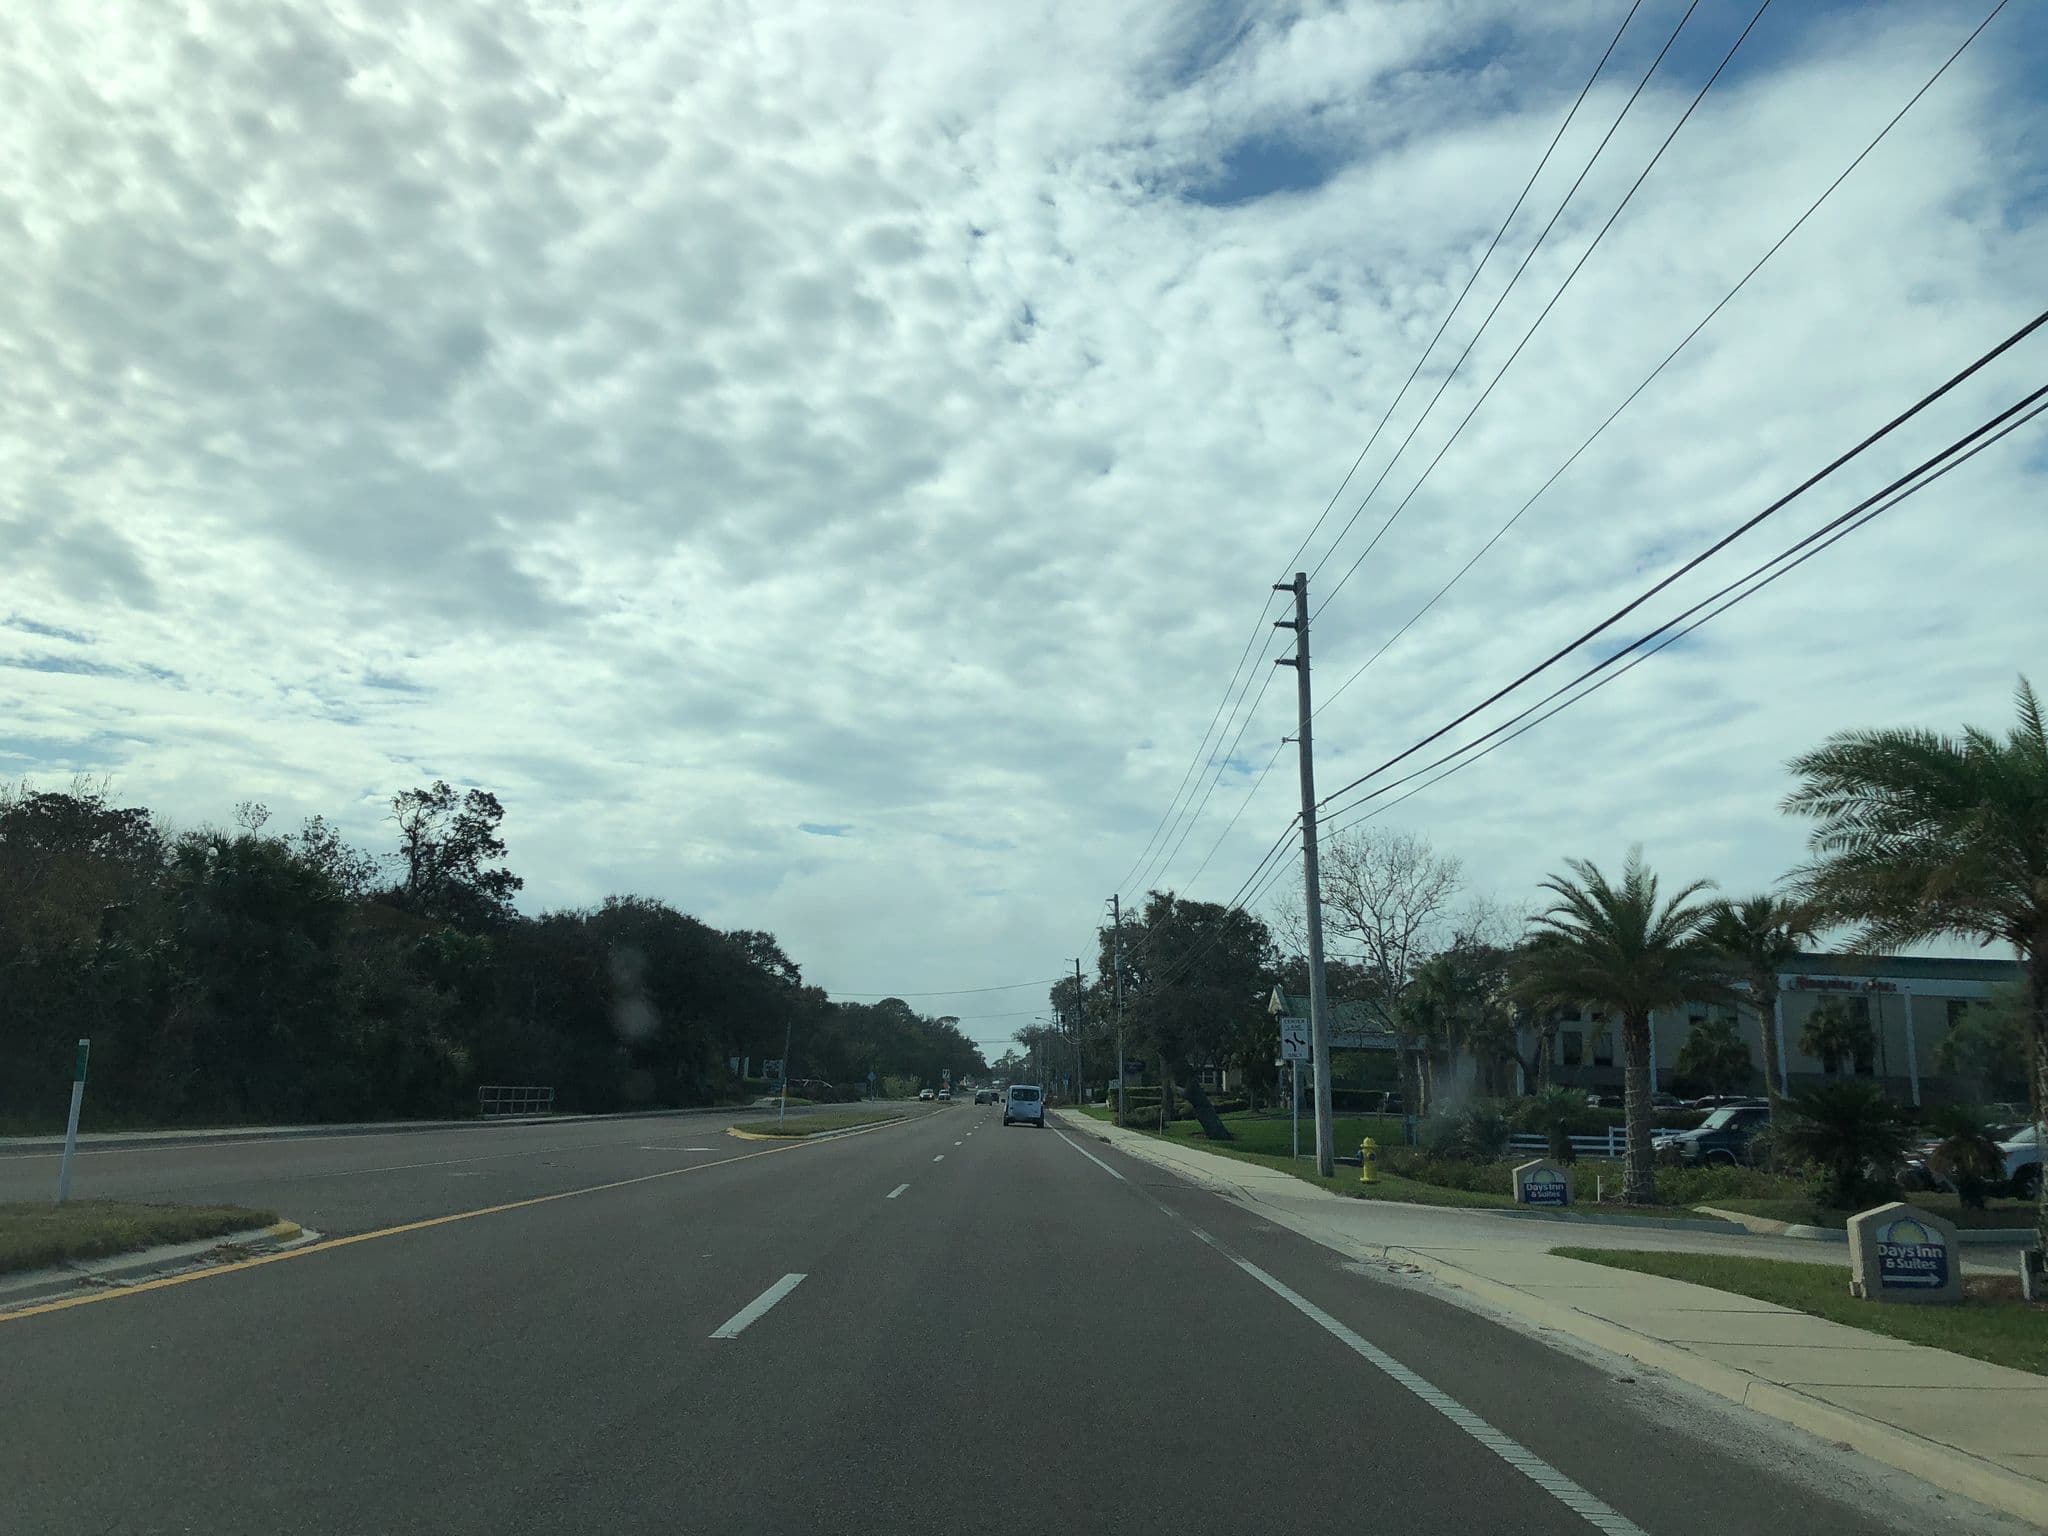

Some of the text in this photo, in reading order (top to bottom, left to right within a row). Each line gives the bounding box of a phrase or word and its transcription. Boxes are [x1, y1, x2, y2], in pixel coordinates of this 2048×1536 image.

[1879, 1244, 1943, 1258] Days Inn
[1886, 1259, 1937, 1270] & Suites
